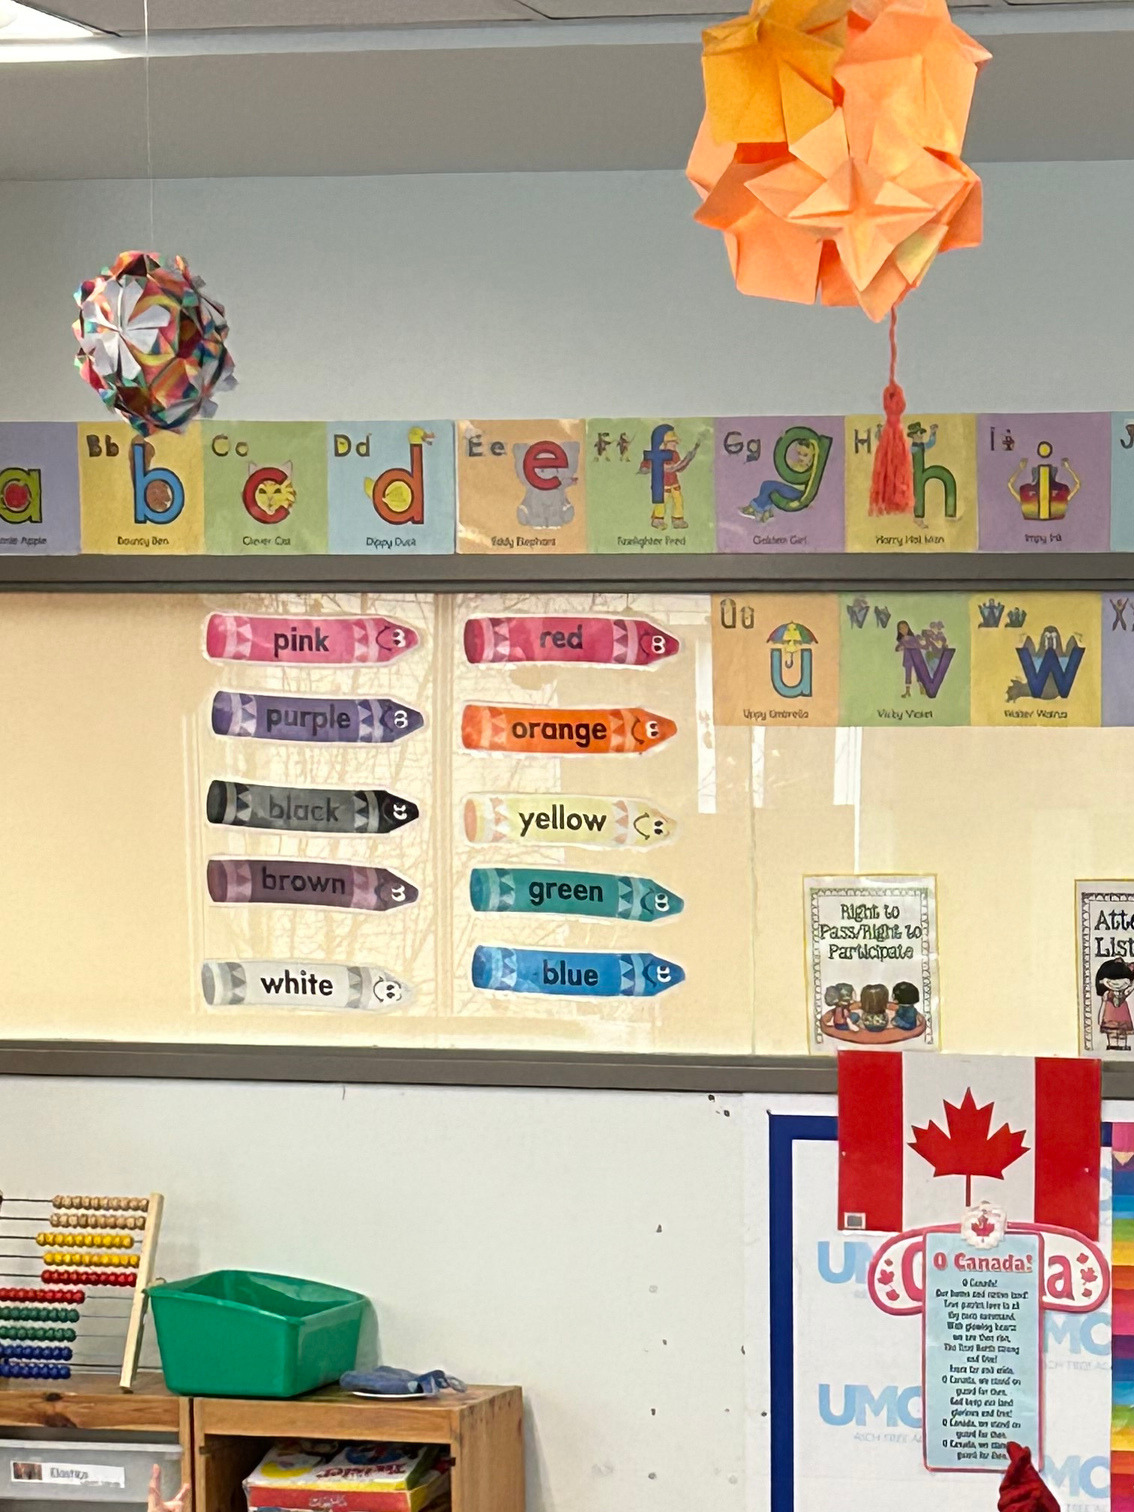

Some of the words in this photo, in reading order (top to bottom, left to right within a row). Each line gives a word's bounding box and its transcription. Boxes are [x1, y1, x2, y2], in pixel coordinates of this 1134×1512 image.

[522, 441, 570, 491] e
[643, 423, 674, 505] f
[769, 425, 833, 513] g
[133, 442, 186, 525] b
[242, 467, 291, 525] c
[371, 442, 425, 525] d
[912, 442, 957, 519] h
[273, 626, 330, 657] pink
[539, 624, 583, 650] red
[769, 647, 813, 698] u
[910, 646, 956, 698] v
[1015, 646, 1086, 699] w
[266, 703, 351, 736] purple
[511, 717, 607, 748] orange
[268, 794, 342, 824] black
[518, 805, 607, 837] yellow
[261, 866, 346, 896] brown
[528, 878, 604, 904] green
[840, 903, 880, 922] Right
[884, 904, 900, 919] to
[819, 923, 903, 942] Pass/Right
[905, 924, 922, 939] to
[828, 943, 914, 962] Participate
[260, 968, 334, 997] white
[542, 959, 598, 986] blue
[933, 1252, 948, 1271] O
[954, 1252, 1034, 1274] Canada!
[819, 1383, 923, 1429] UMC
